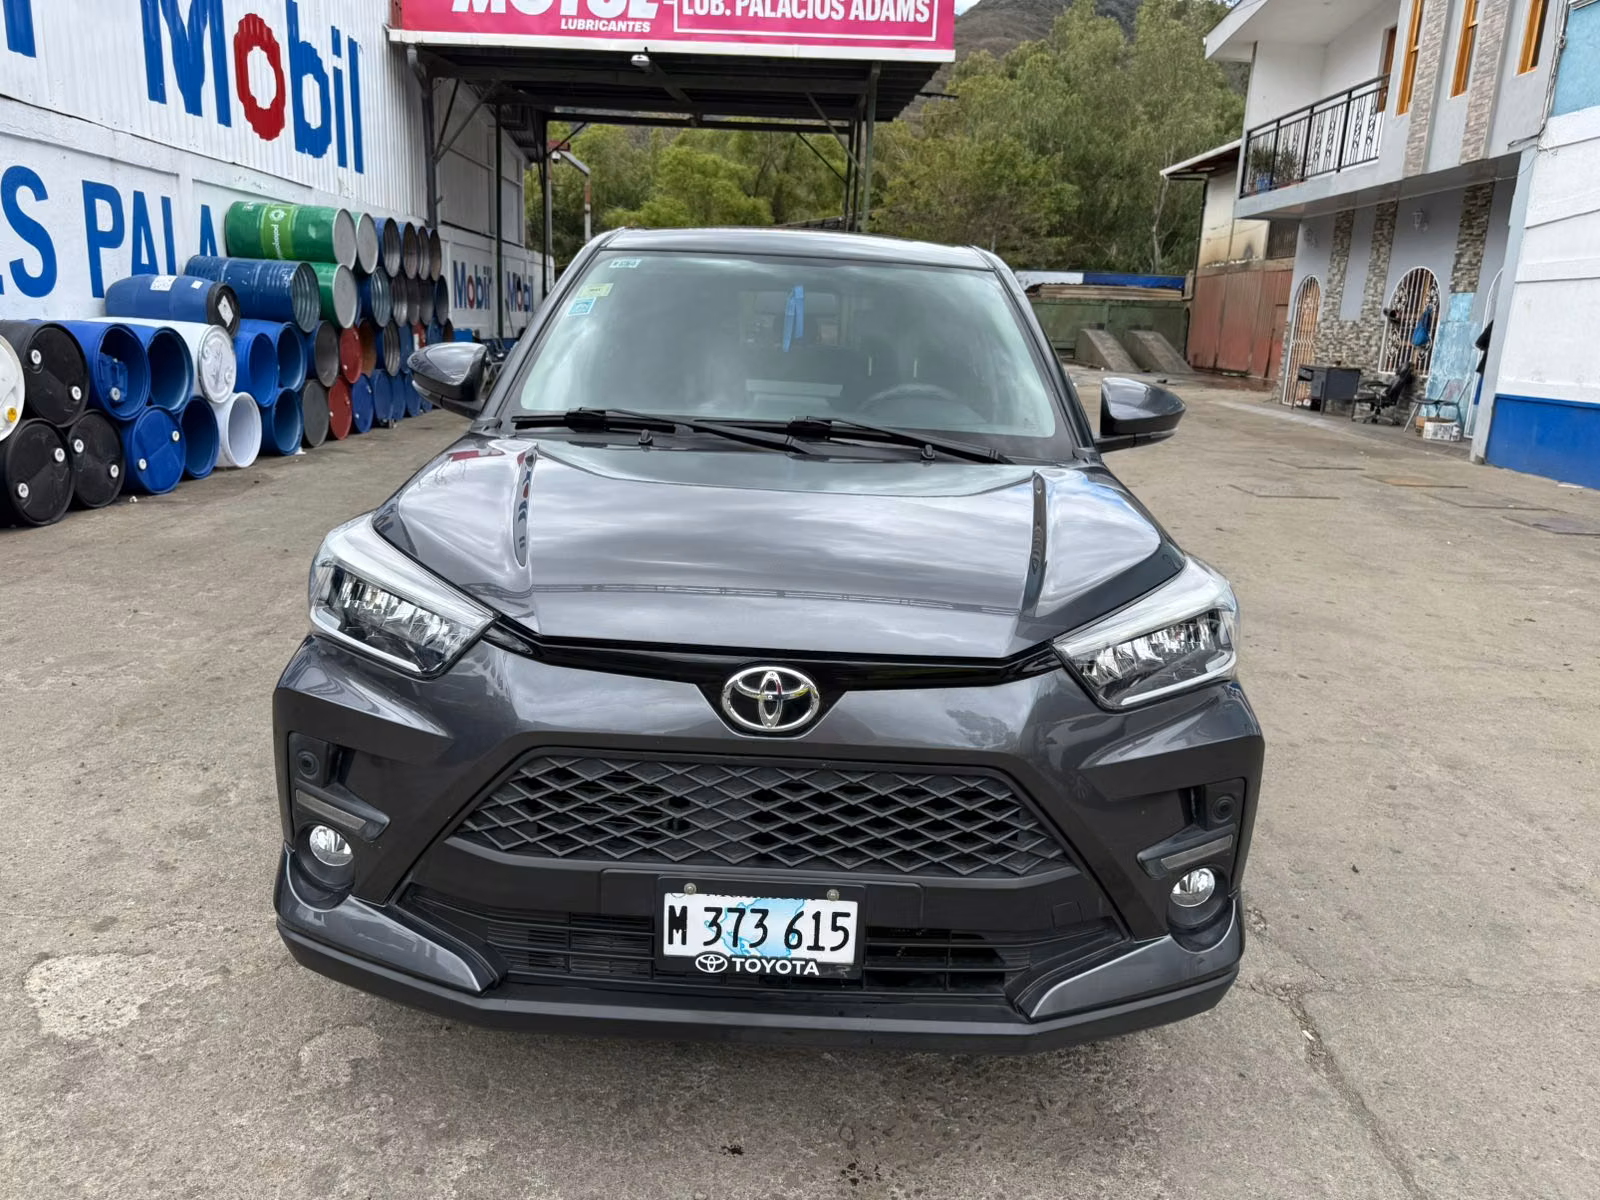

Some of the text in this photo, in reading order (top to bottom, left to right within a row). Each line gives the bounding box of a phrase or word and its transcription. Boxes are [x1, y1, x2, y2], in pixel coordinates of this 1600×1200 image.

[561, 18, 651, 33] LUBRICANTES
[142, 0, 364, 174] Mobil
[0, 165, 57, 298] S
[453, 260, 492, 311] Mobil
[667, 905, 851, 951] M 373 615
[731, 957, 820, 976] TOYOTA
